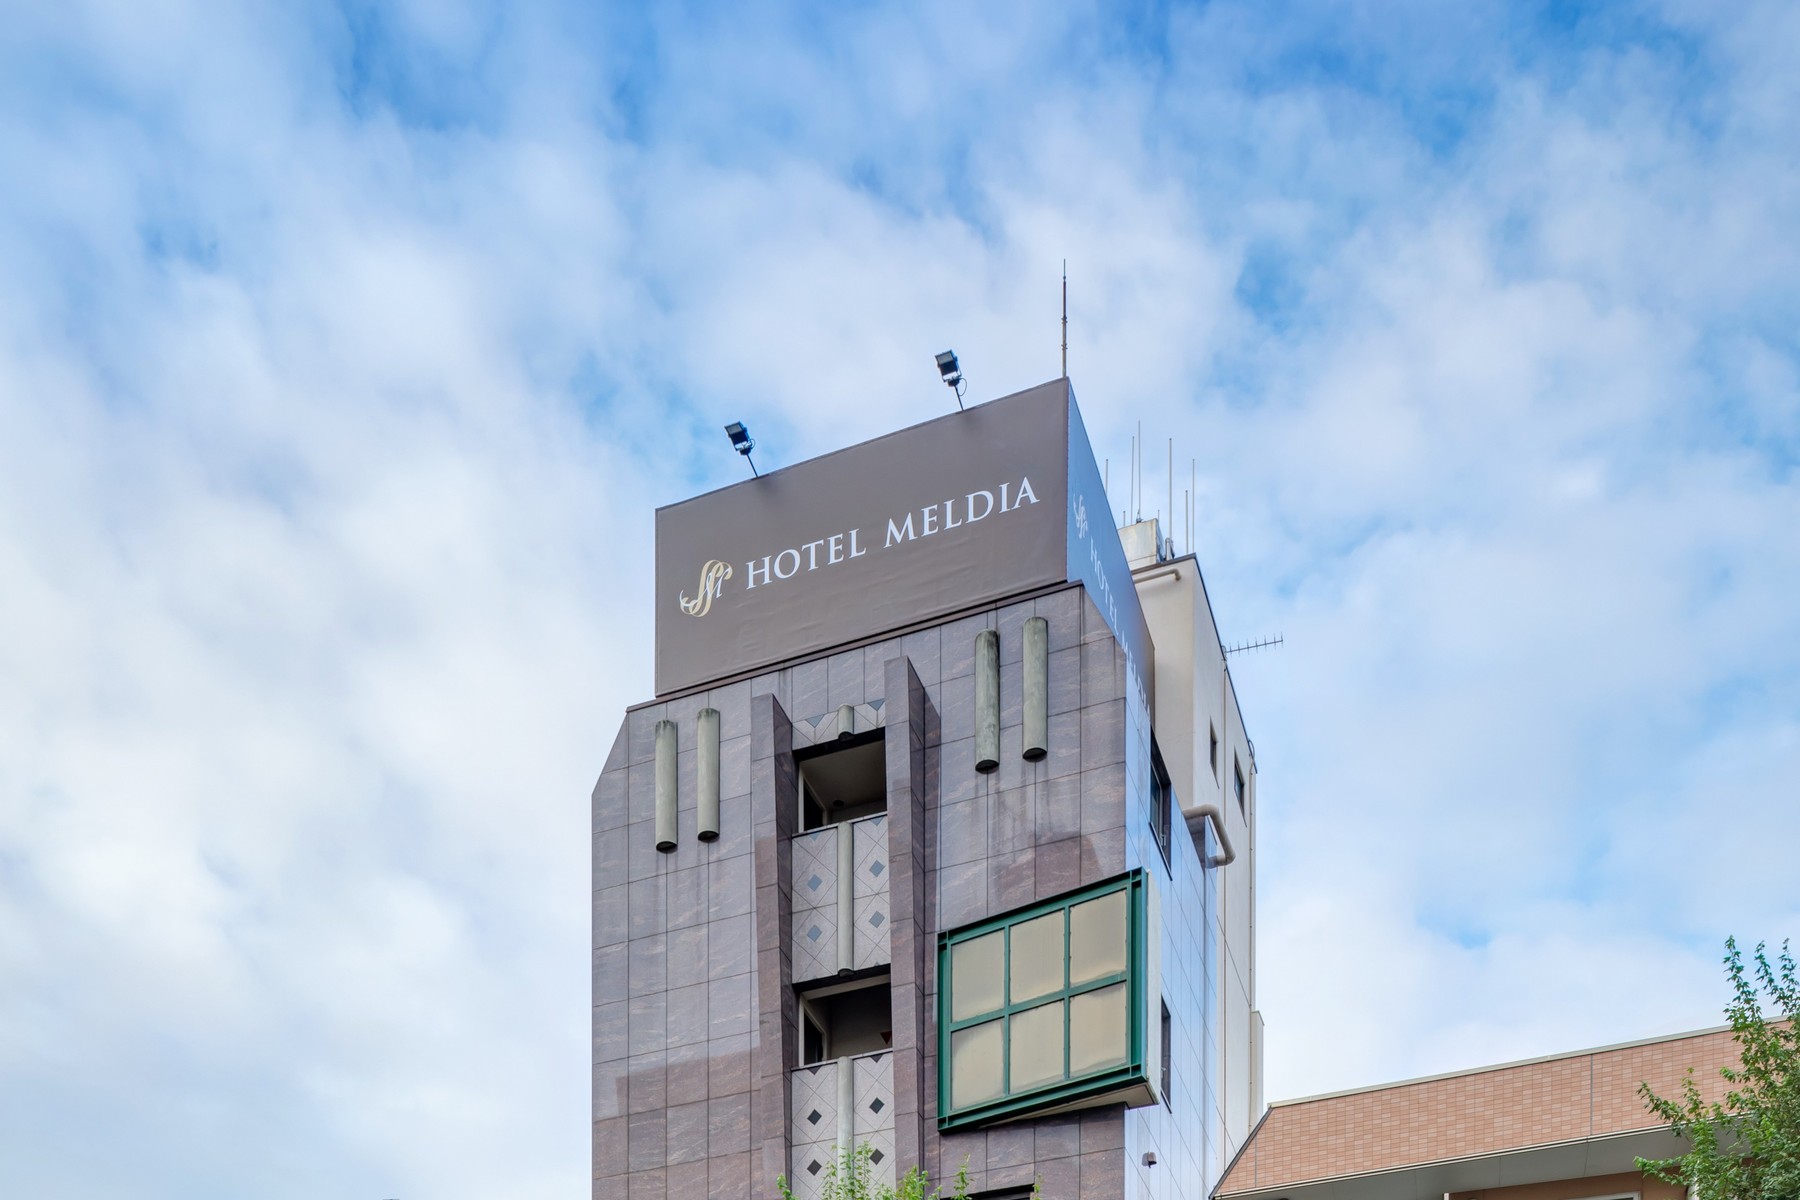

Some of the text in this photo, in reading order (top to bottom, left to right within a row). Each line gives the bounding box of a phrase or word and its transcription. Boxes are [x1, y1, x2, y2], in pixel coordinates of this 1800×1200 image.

[746, 476, 1040, 590] HOTEL MELDIA
[1090, 535, 1119, 636] HOTEL
